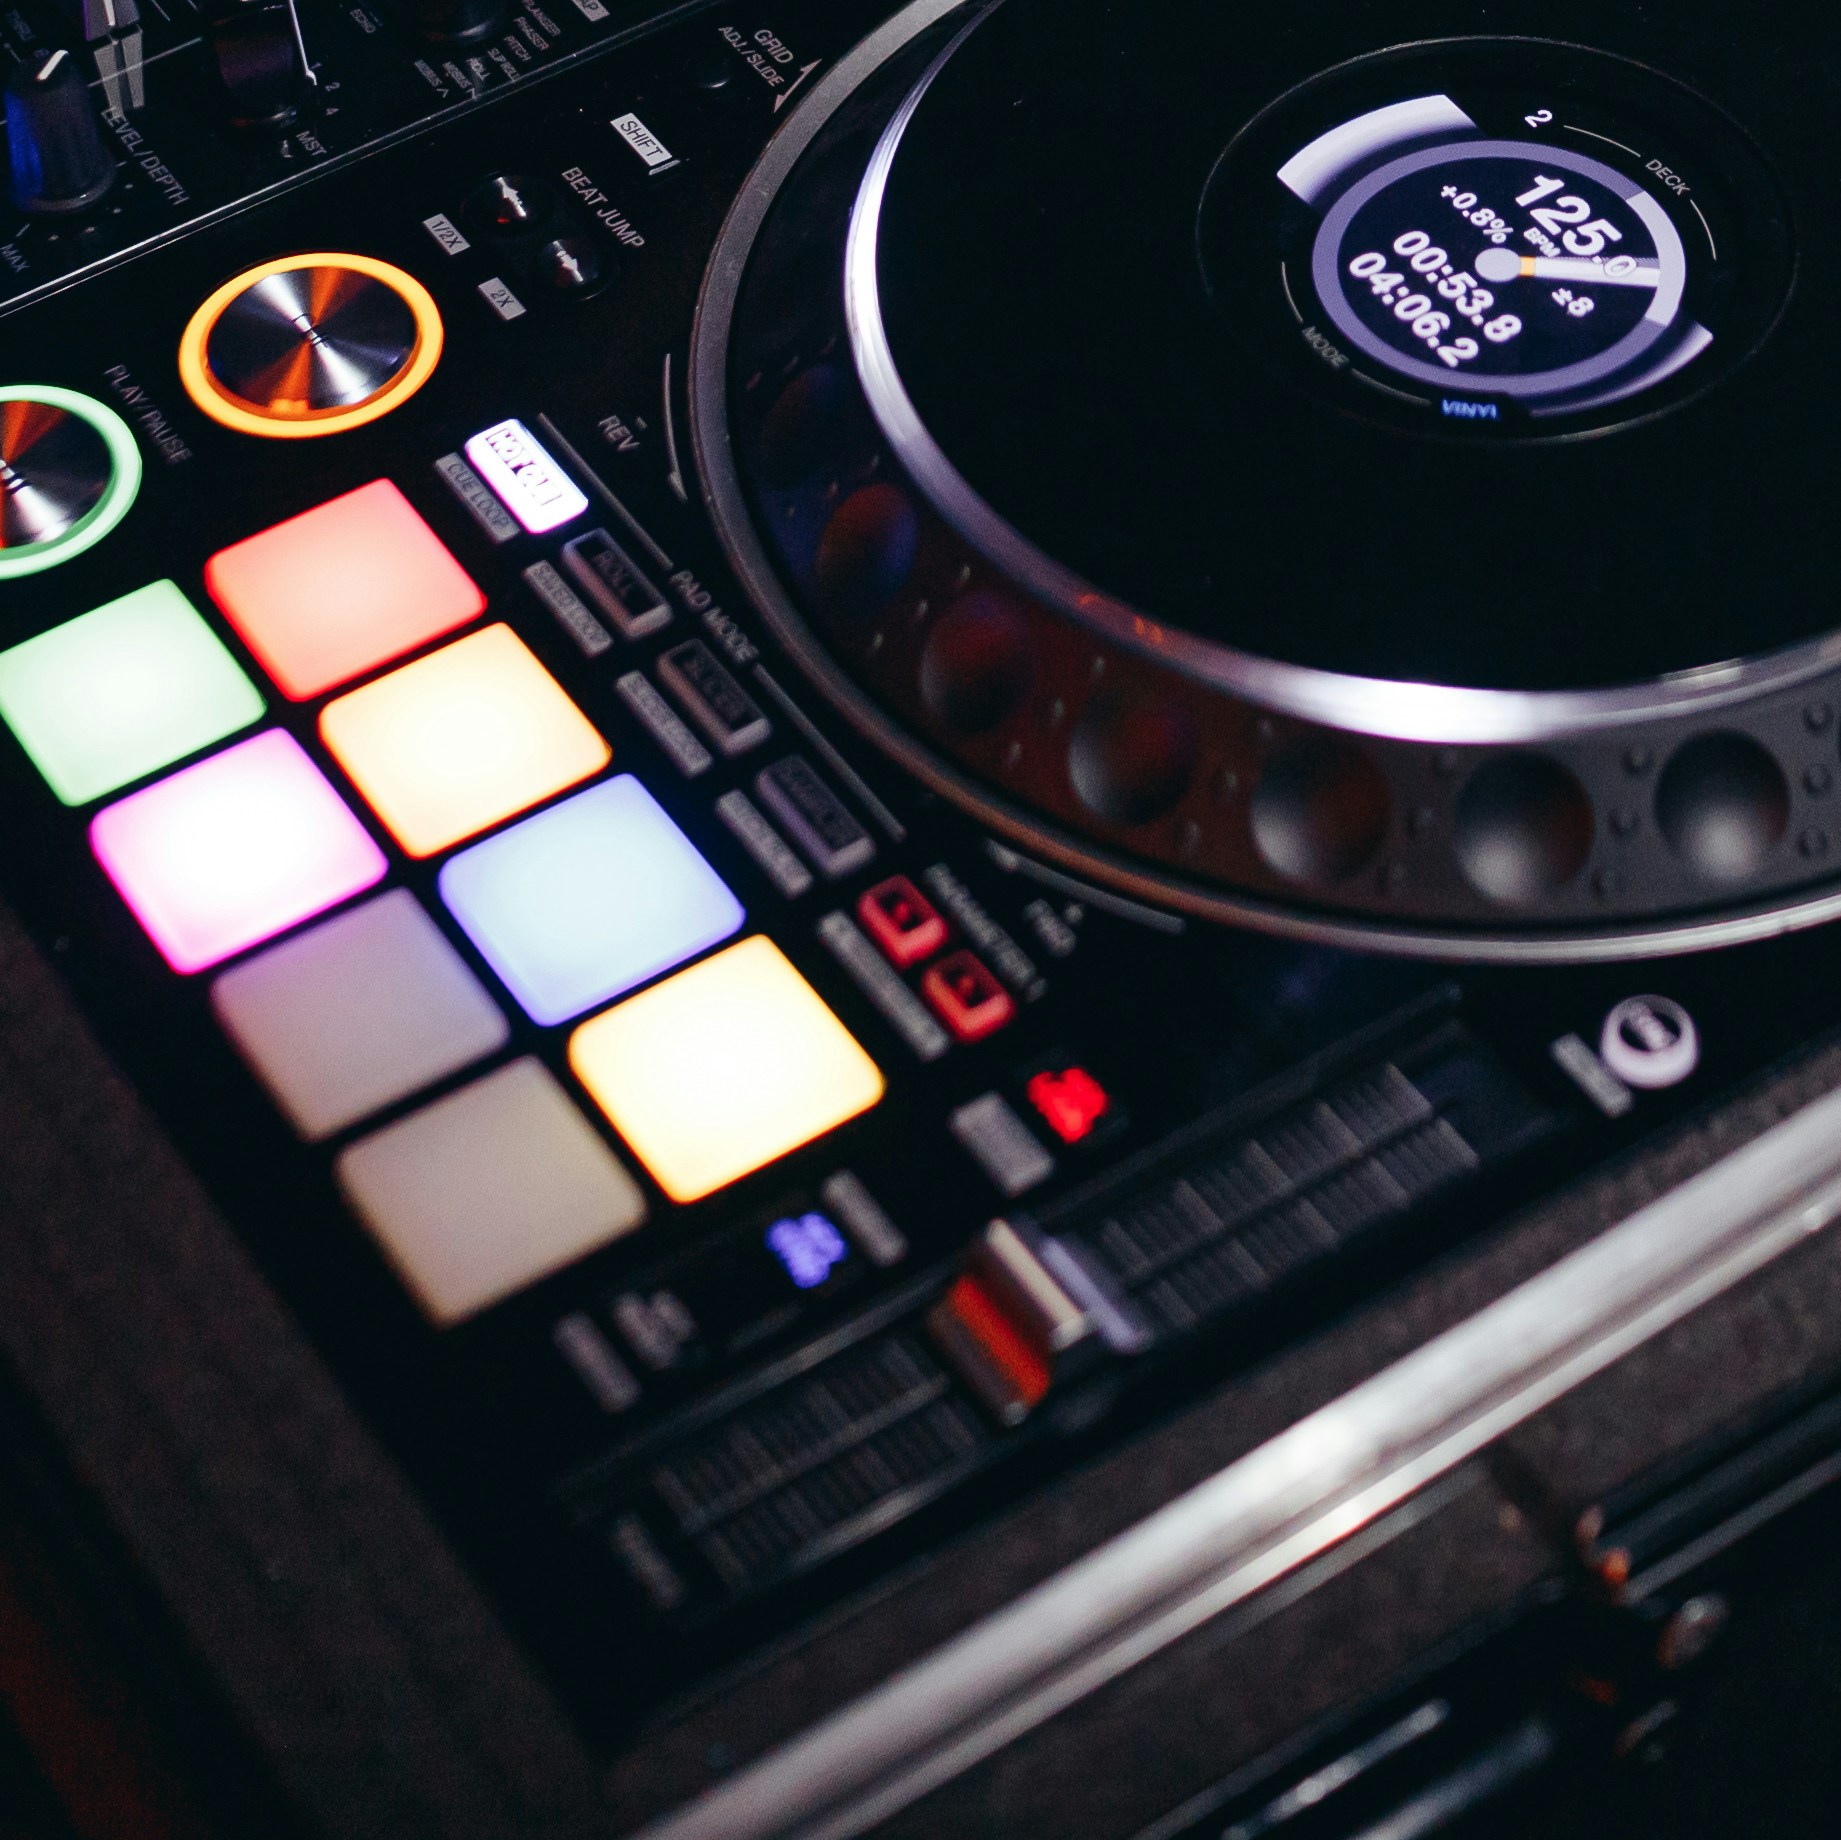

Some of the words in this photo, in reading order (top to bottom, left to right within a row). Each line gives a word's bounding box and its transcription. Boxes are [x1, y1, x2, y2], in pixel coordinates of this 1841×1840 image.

[503, 34, 532, 62] PITCH
[513, 16, 550, 52] PHASER
[754, 29, 794, 64] GRID
[718, 26, 785, 87] ADJ./SLIDE
[1525, 109, 1553, 127] 2
[101, 108, 190, 206] LEVEL/DEPTH
[295, 130, 327, 156] MST
[620, 120, 664, 157] SHIFT
[1644, 158, 1692, 197] DECK
[561, 166, 609, 206] BEAT
[597, 209, 646, 247] JUMP
[1440, 185, 1514, 244] +0.8%
[431, 220, 463, 248] 1/2X
[1515, 175, 1637, 278] 125.0
[1523, 227, 1561, 258] BPM
[0, 243, 31, 275] MAX
[490, 288, 515, 308] 2X
[1393, 230, 1522, 342] 00:53.8
[1349, 252, 1479, 367] 04:06.2
[1302, 326, 1350, 369] MODE
[103, 364, 193, 464] PLAY/PAUSE
[597, 415, 640, 453] REV
[447, 462, 480, 495] CUE
